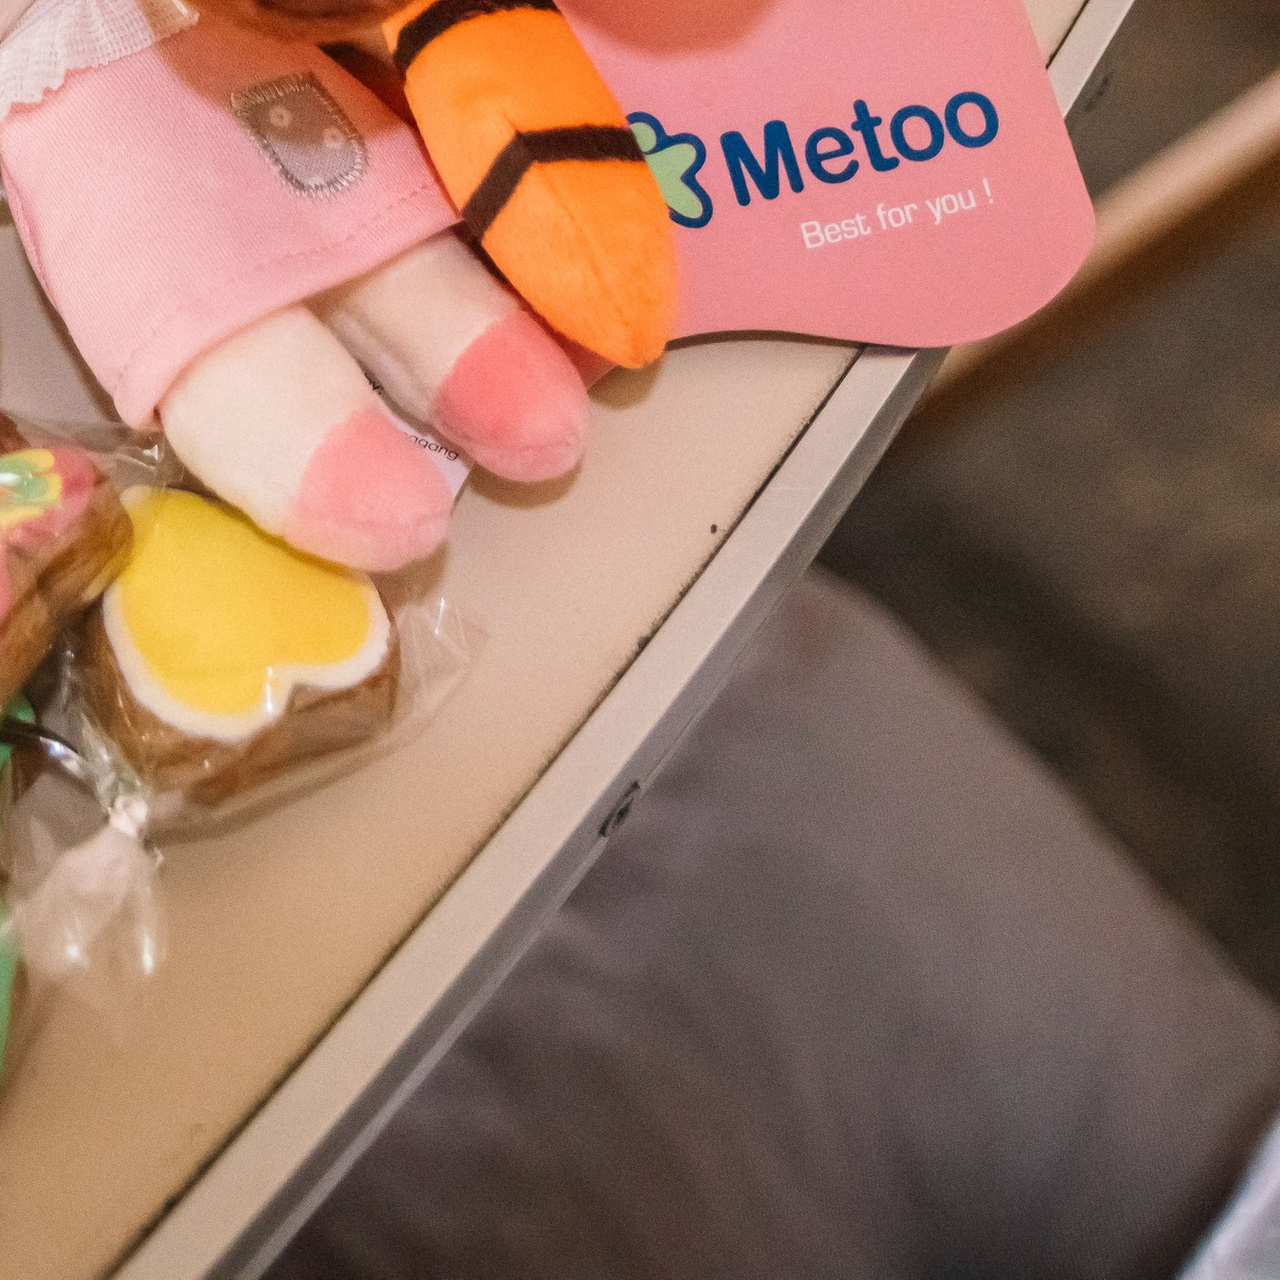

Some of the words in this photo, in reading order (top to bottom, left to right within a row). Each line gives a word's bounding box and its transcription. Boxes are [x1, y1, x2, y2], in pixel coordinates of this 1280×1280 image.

[720, 91, 999, 206] Metoo
[801, 210, 872, 249] Best
[876, 200, 918, 229] for
[924, 187, 977, 225] you
